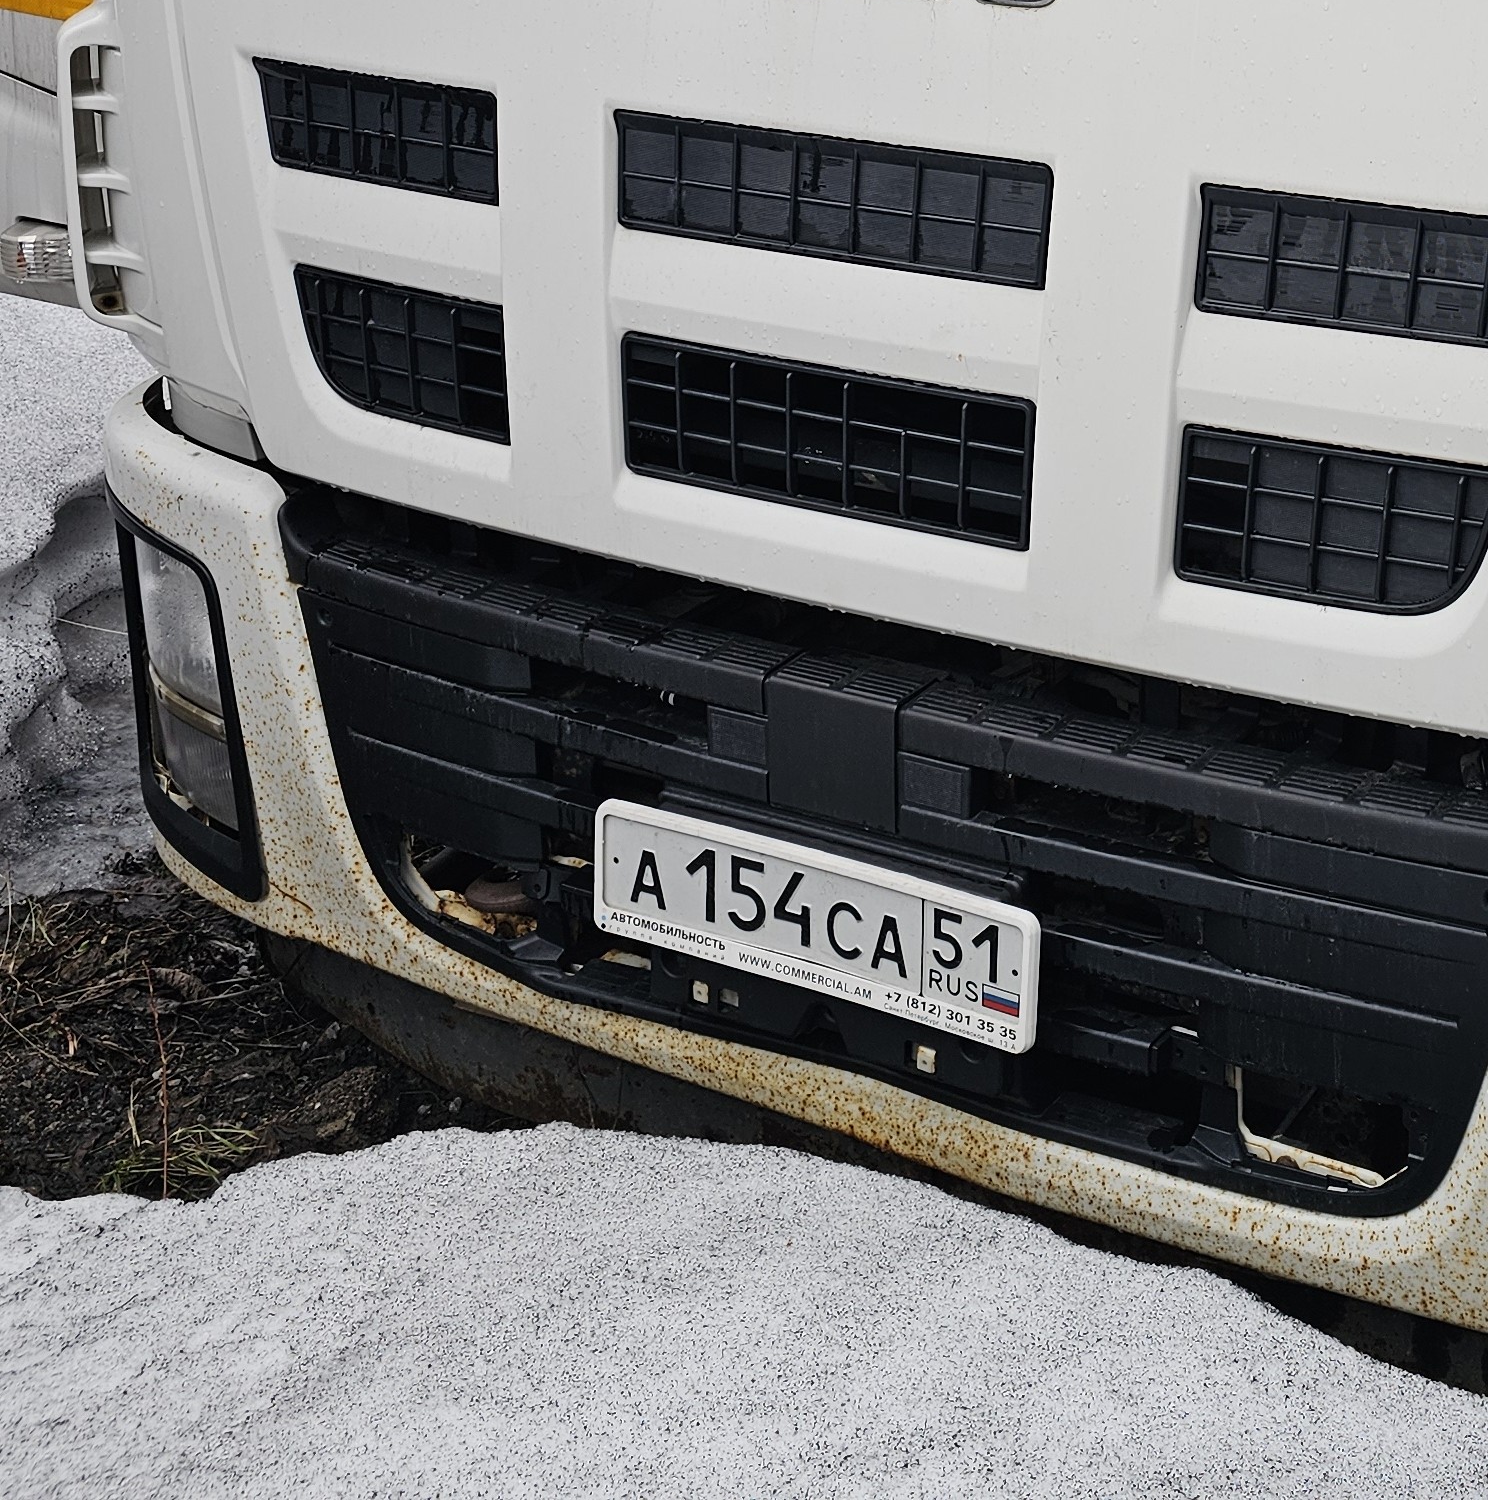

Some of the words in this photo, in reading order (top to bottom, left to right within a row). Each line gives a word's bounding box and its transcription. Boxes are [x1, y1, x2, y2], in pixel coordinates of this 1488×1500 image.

[610, 911, 726, 951] АВТОМОБИЛЬНОСТЬ
[932, 906, 1001, 984] 51
[738, 951, 872, 1000] WWW.COMMERCIAL.AM
[928, 968, 979, 1003] RUS
[884, 991, 902, 1003] +7
[906, 995, 941, 1018] (812)
[945, 1008, 971, 1026] 301
[976, 1018, 995, 1033] 35
[999, 1025, 1017, 1041] 35
